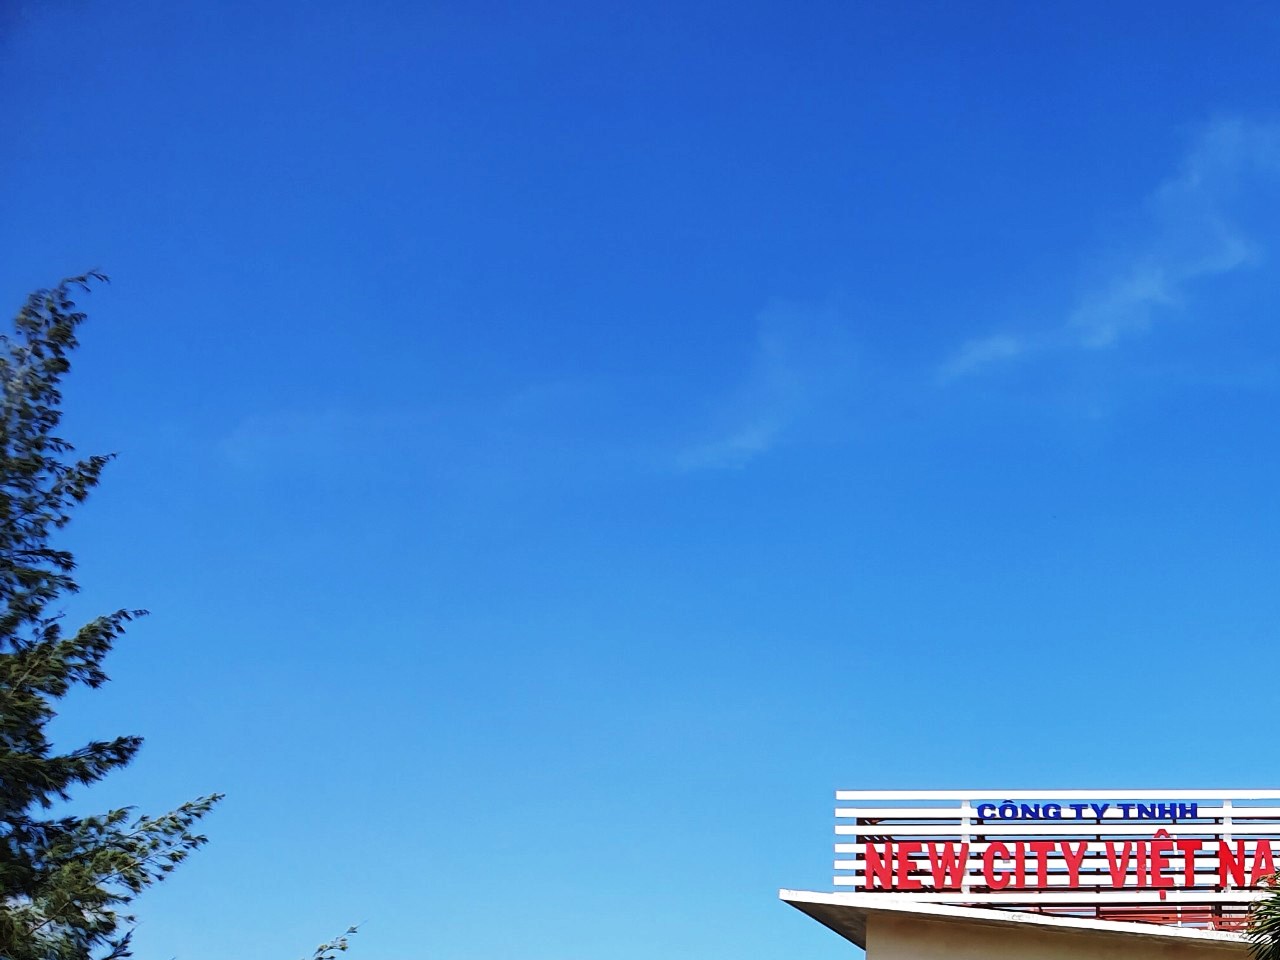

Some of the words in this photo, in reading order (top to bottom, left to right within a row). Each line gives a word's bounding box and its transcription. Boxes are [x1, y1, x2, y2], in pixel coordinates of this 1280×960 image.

[977, 800, 1062, 820] CÔNG
[1070, 803, 1110, 820] TY
[1117, 803, 1198, 820] TNHH
[865, 841, 969, 889] NEW
[984, 841, 1088, 890] CITY
[1105, 828, 1203, 900] VIỆT
